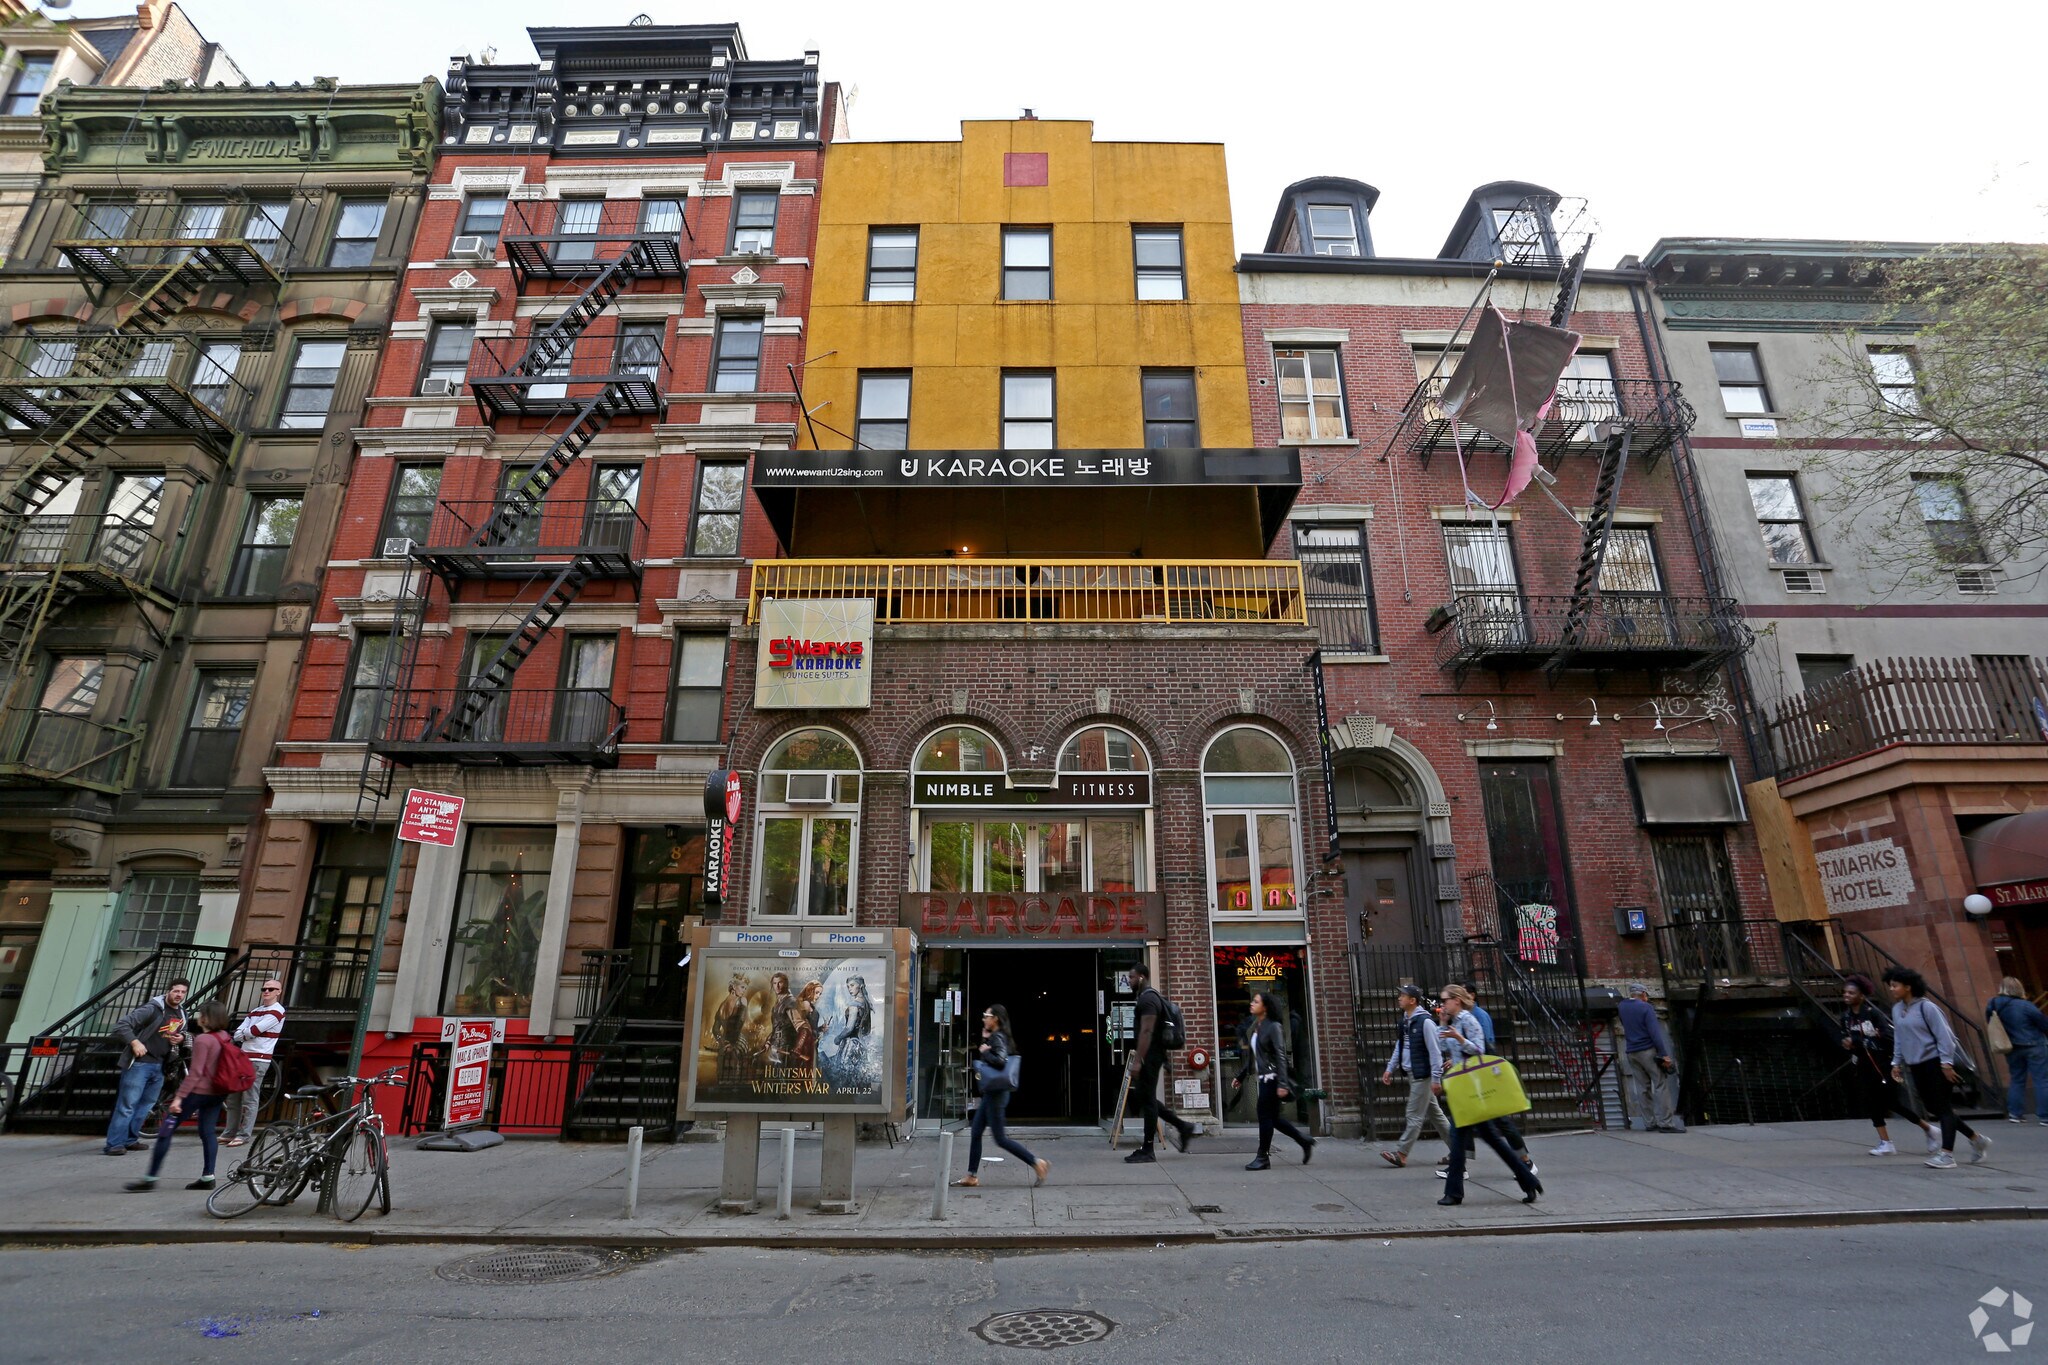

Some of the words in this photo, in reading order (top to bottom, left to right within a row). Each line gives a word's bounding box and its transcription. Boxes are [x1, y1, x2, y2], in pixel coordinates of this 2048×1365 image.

[927, 458, 1065, 477] KARAOKE
[1074, 457, 1152, 477] 노래방
[793, 639, 864, 656] Marks
[795, 658, 862, 670] KARAOKE
[782, 671, 814, 679] LOUNGE
[814, 671, 820, 679] &
[822, 671, 850, 679] SUITES
[926, 783, 994, 796] NIMBLE
[1072, 783, 1135, 796] FITNESS
[411, 796, 423, 804] NO
[670, 846, 682, 860] 8
[706, 818, 722, 892] KARAOKE
[1831, 879, 1893, 904] HOTEL
[18, 896, 30, 906] 10
[920, 896, 1149, 935] BARCADE
[736, 932, 774, 943] Phone
[829, 933, 866, 944] Phone
[1236, 967, 1283, 976] BARCADE
[457, 1050, 466, 1064] MAC
[467, 1049, 472, 1062] &
[764, 1065, 822, 1079] HUNTSMAN
[751, 1080, 802, 1094] WINTER'S
[804, 1080, 830, 1094] WAR
[836, 1087, 861, 1095] APRIL
[862, 1087, 872, 1095] 22
